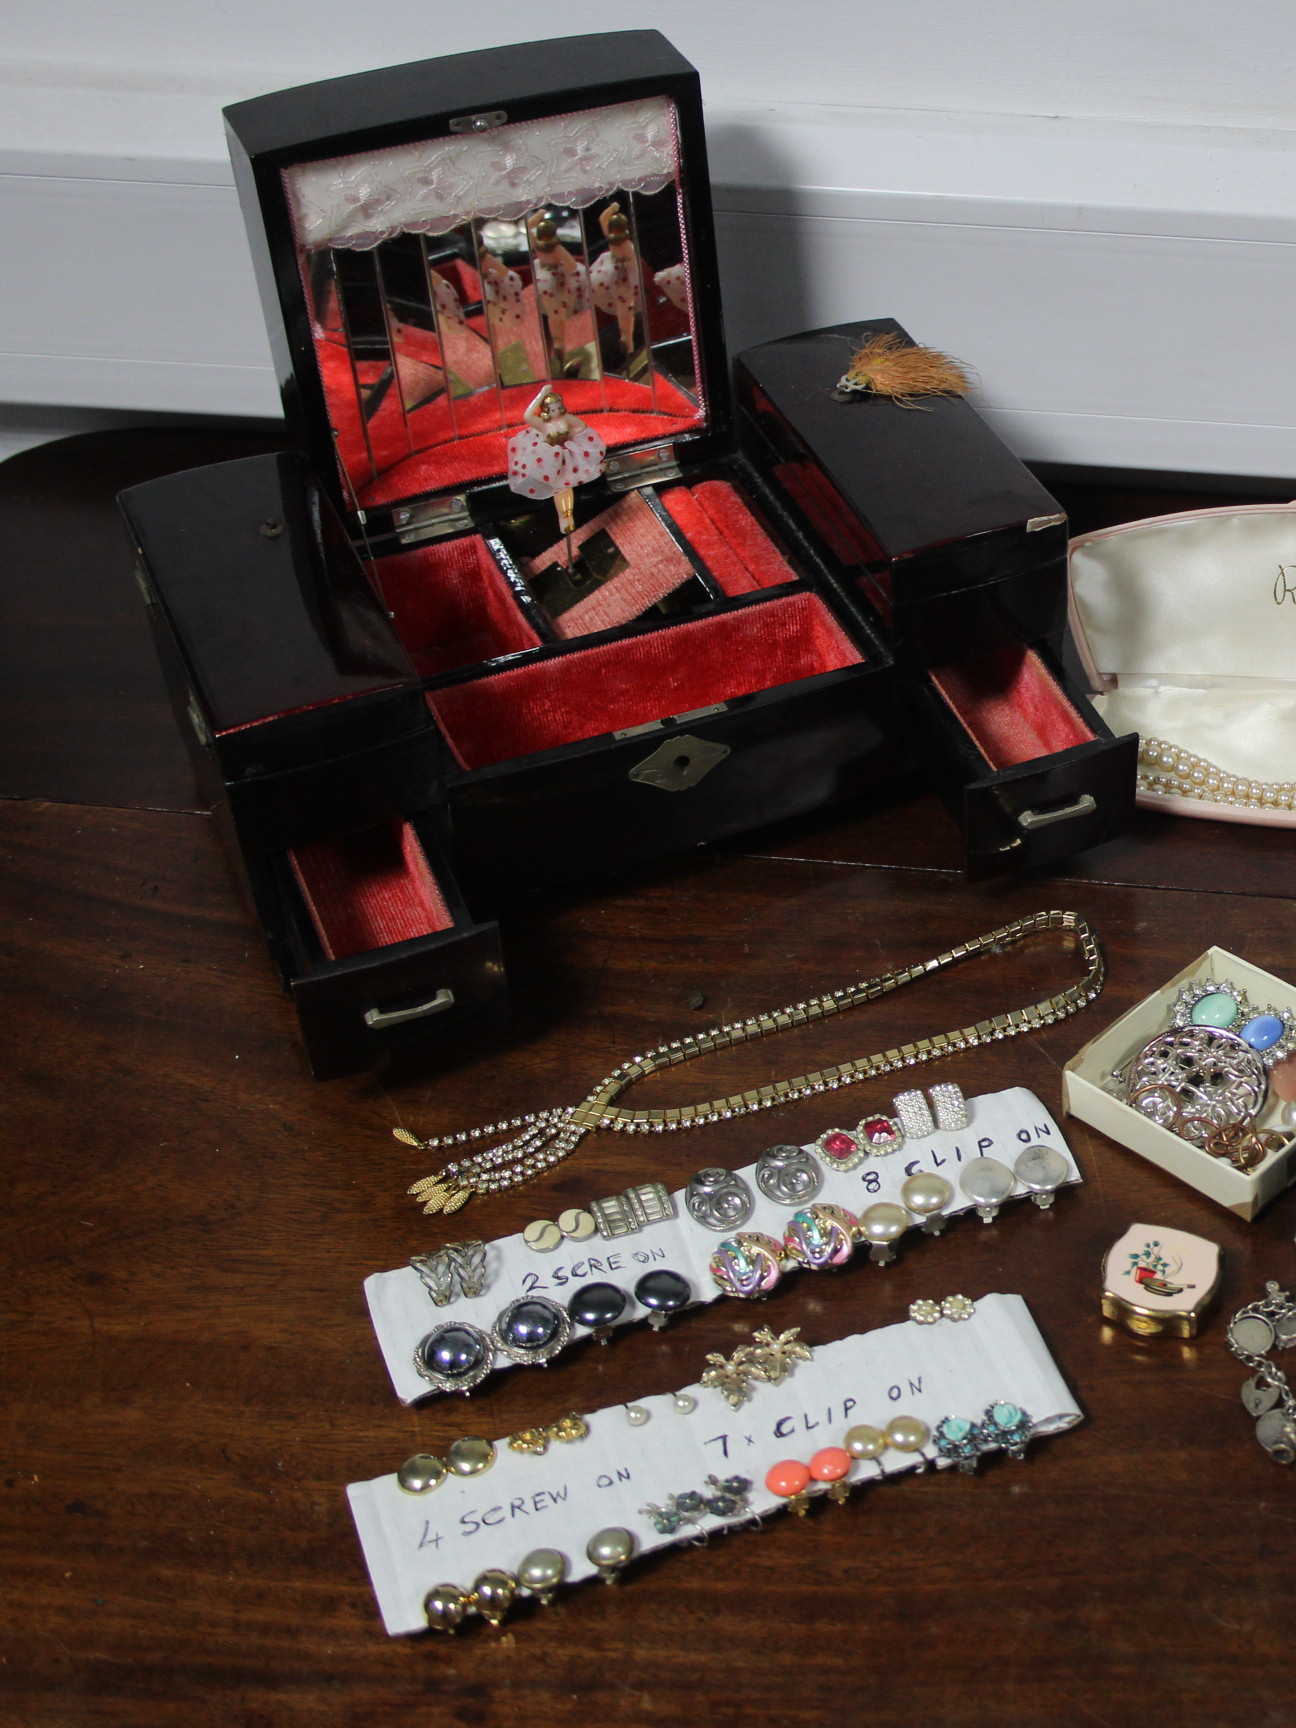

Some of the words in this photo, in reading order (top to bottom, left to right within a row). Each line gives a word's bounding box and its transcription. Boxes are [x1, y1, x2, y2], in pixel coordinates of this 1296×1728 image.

[861, 1171, 881, 1193] 8
[904, 1136, 994, 1178] CLIP
[1016, 1123, 1052, 1144] ON
[521, 1272, 549, 1294] 2
[631, 1247, 666, 1264] ON
[773, 1397, 857, 1439] CLIP
[888, 1375, 923, 1401] ON
[418, 1520, 444, 1550] 4
[459, 1483, 568, 1537] SCREW
[596, 1466, 631, 1489] ON
